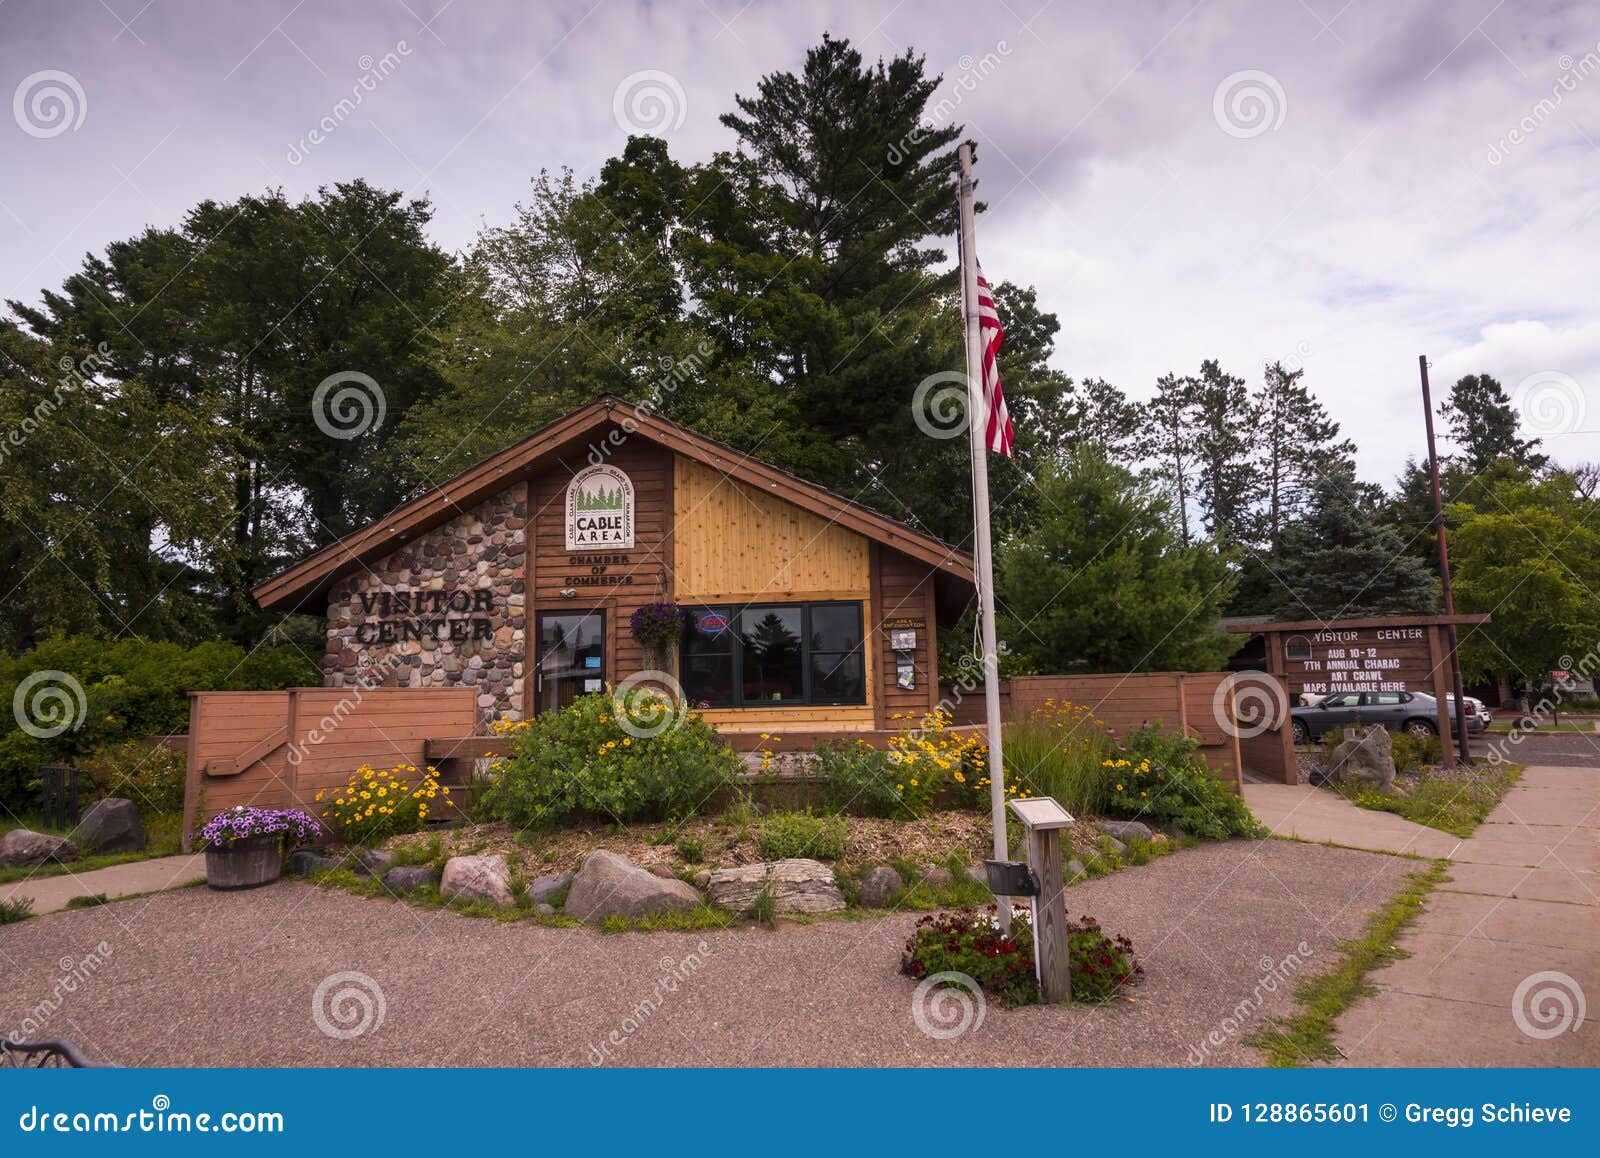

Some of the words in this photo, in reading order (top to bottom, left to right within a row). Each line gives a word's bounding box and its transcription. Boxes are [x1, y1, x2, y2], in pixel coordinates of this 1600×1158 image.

[577, 516, 622, 531] CABLE
[569, 554, 629, 564] CHAMBER
[591, 566, 607, 575] OF
[565, 576, 633, 585] COMMERCE
[358, 588, 494, 614] VISITOR
[356, 618, 494, 644] CENTER
[1315, 631, 1358, 642] VISITOR
[1377, 629, 1423, 640] CENTER
[1328, 649, 1345, 659] AUG
[1349, 648, 1377, 658] 10-12
[1303, 661, 1321, 671] 7TH
[1326, 660, 1360, 670] ANNUAL
[1364, 659, 1400, 669] CHARAC
[1331, 672, 1348, 681] ART
[1353, 671, 1383, 681] CRAWL
[1303, 683, 1327, 693] MAPS
[1330, 682, 1378, 692] AVAILABLE
[1380, 682, 1406, 692] HERE
